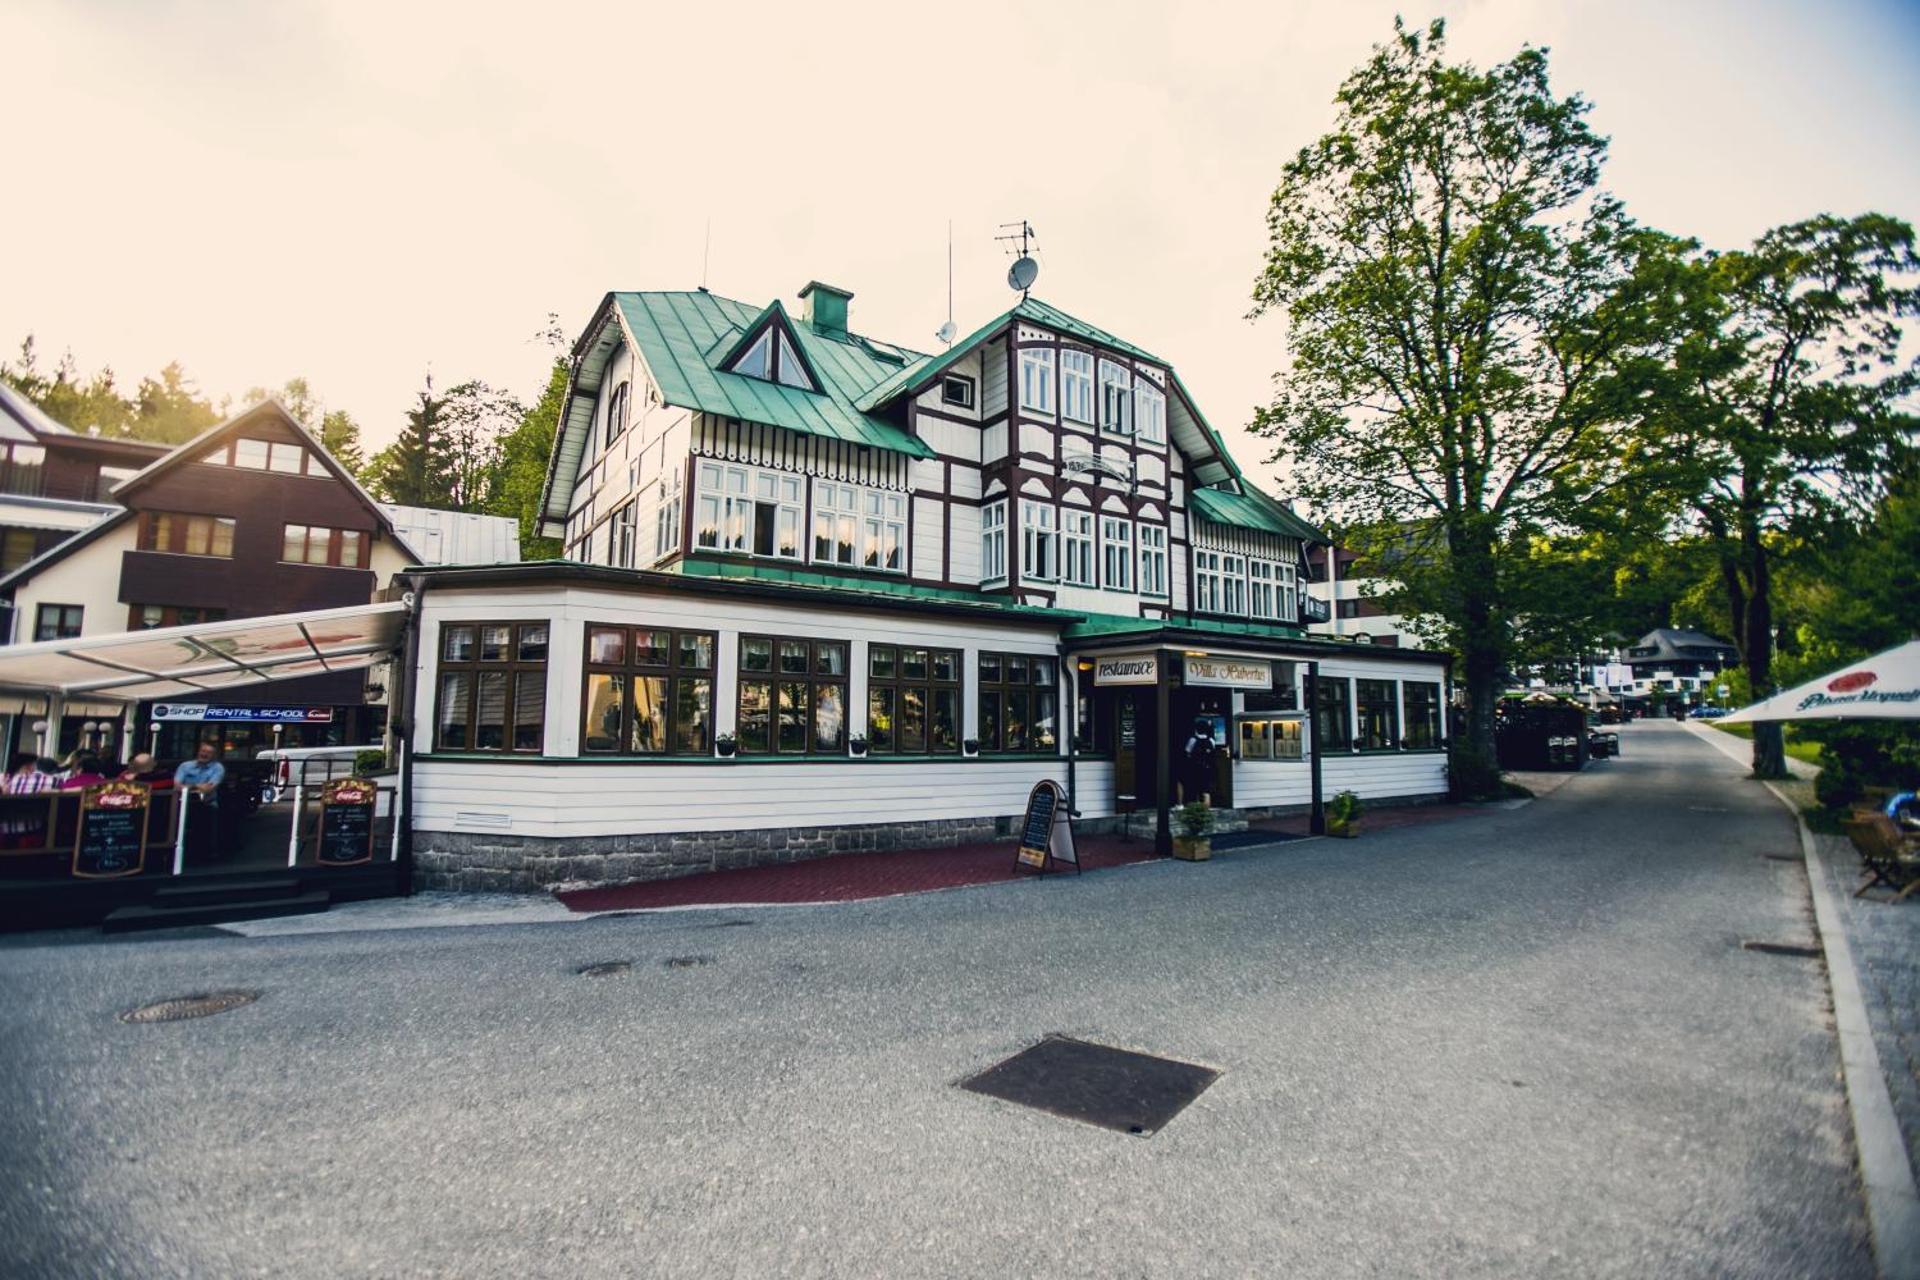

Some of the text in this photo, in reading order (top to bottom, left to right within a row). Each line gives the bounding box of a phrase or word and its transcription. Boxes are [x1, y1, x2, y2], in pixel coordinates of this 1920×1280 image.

[1099, 661, 1154, 677] restaurace
[1189, 662, 1217, 678] Villa
[169, 708, 205, 716] SHOP
[206, 708, 252, 717] RENTAL
[260, 709, 305, 718] SCHOOL
